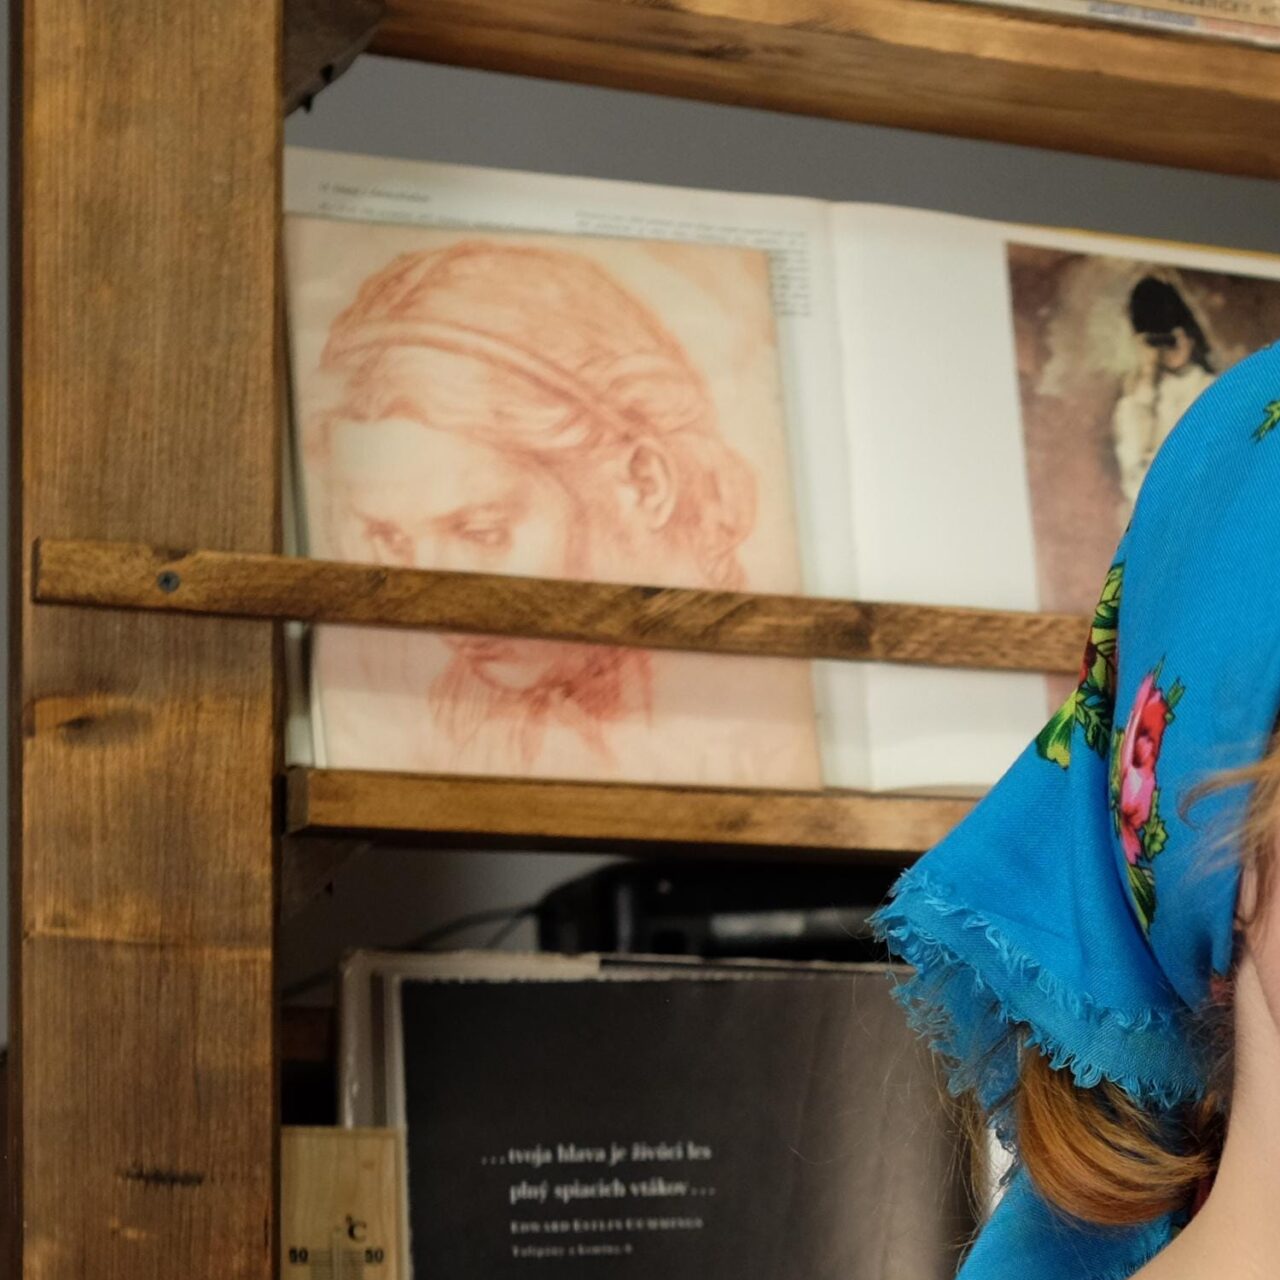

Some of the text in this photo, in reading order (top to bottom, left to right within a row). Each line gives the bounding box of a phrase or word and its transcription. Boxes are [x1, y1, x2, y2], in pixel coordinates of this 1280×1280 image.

[557, 1143, 606, 1163] hlava
[609, 1142, 627, 1167] je
[686, 1141, 712, 1160] les
[510, 1180, 548, 1205] plný
[289, 1247, 308, 1264] 50
[364, 1247, 384, 1263] 50
